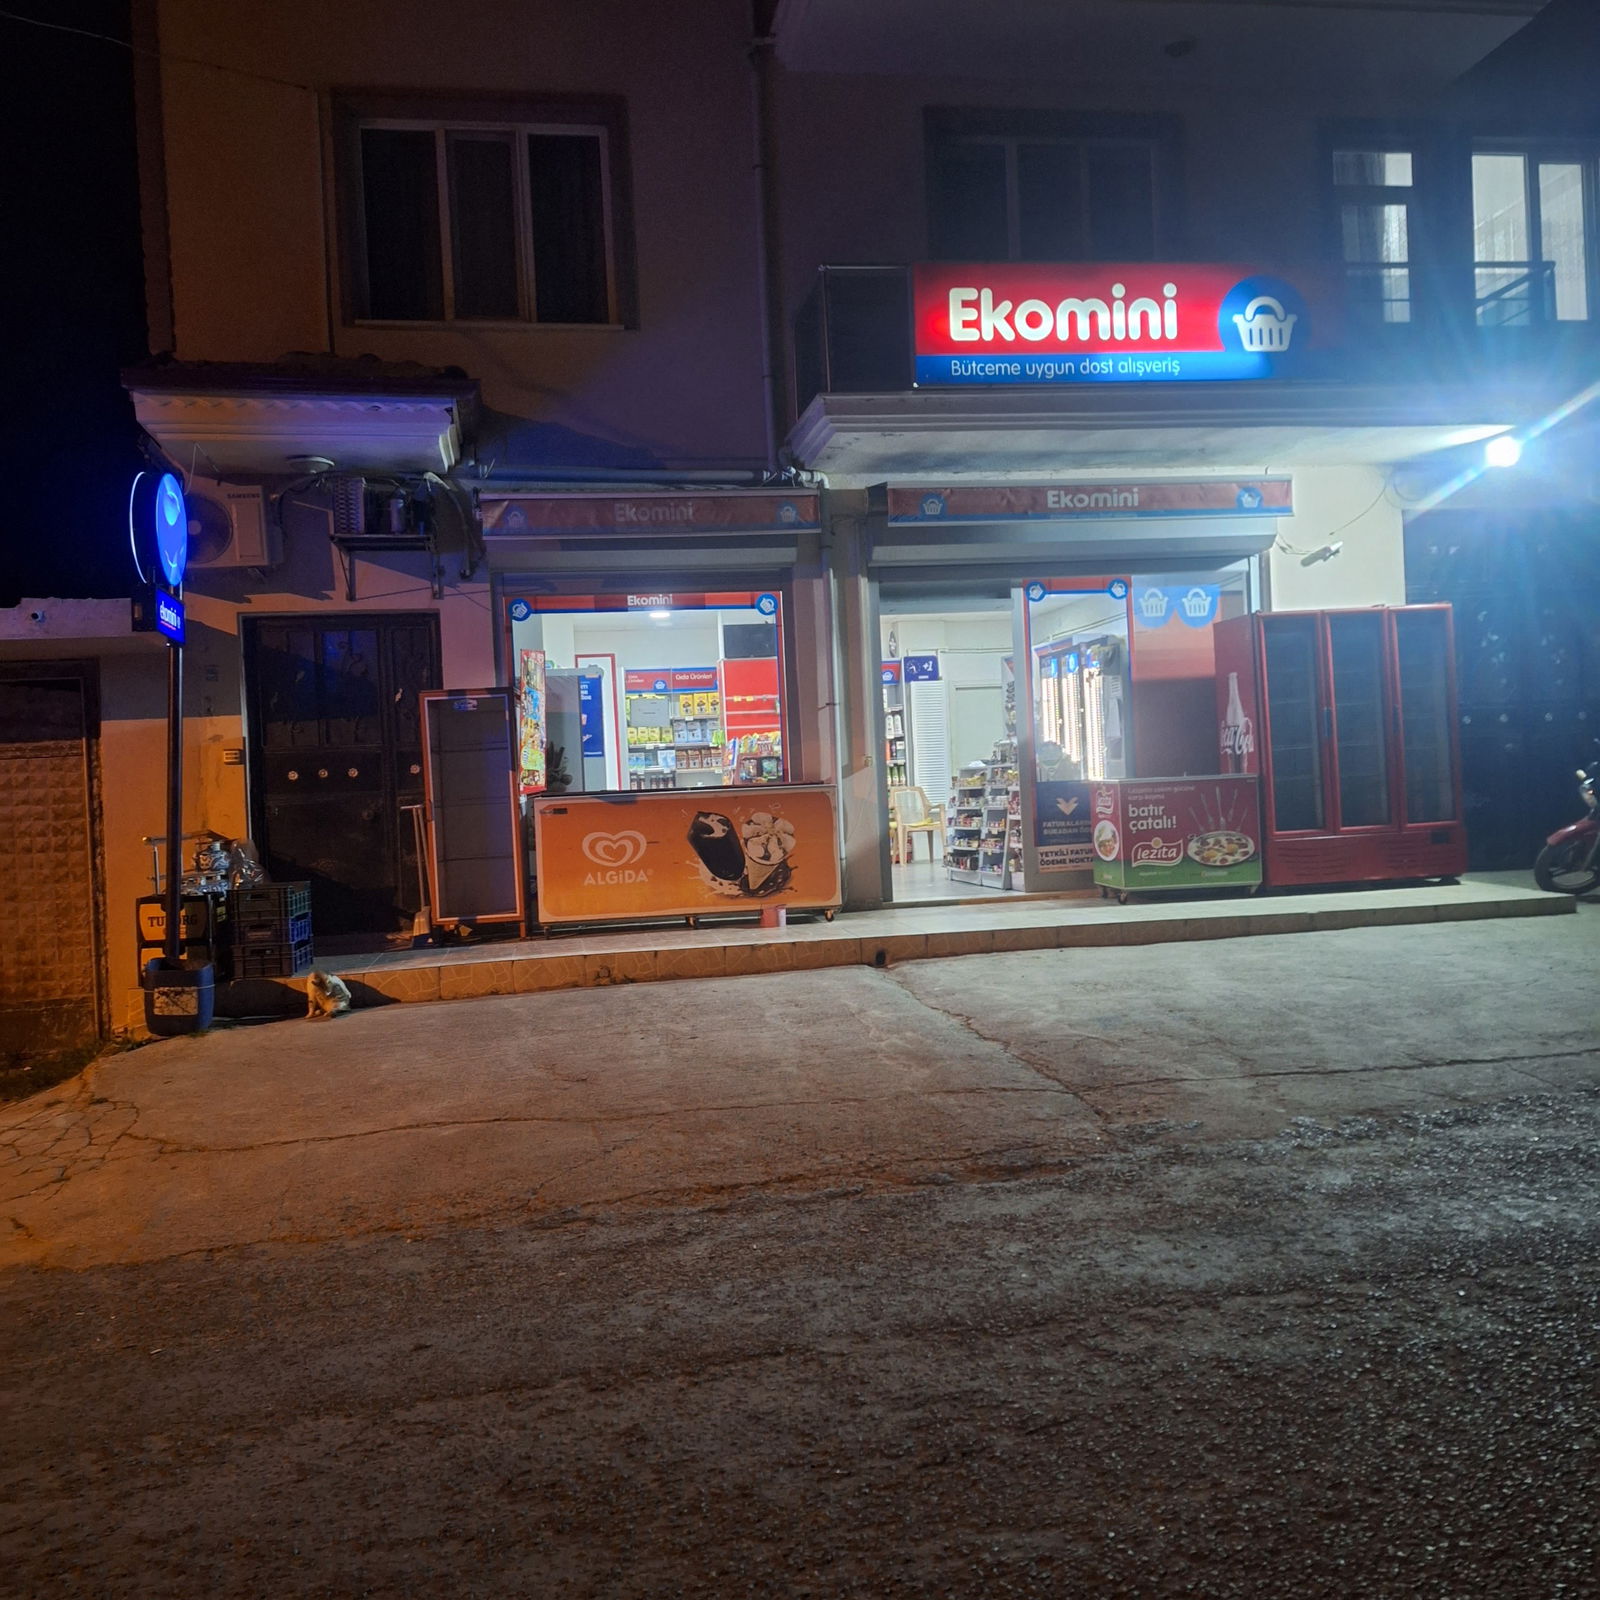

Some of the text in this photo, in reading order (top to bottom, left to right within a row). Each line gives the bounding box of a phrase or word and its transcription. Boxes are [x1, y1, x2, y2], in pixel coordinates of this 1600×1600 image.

[948, 283, 1178, 342] Ekomini
[1025, 362, 1075, 378] uygun
[1080, 358, 1114, 375] dost
[1118, 357, 1181, 376] alışveriş
[1046, 488, 1139, 508] Ekomini
[615, 502, 695, 521] Ekomini
[627, 594, 673, 606] Ekomini
[1128, 804, 1165, 817] batır
[1129, 815, 1177, 833] çatalı!
[1039, 858, 1067, 866] ÖDEME
